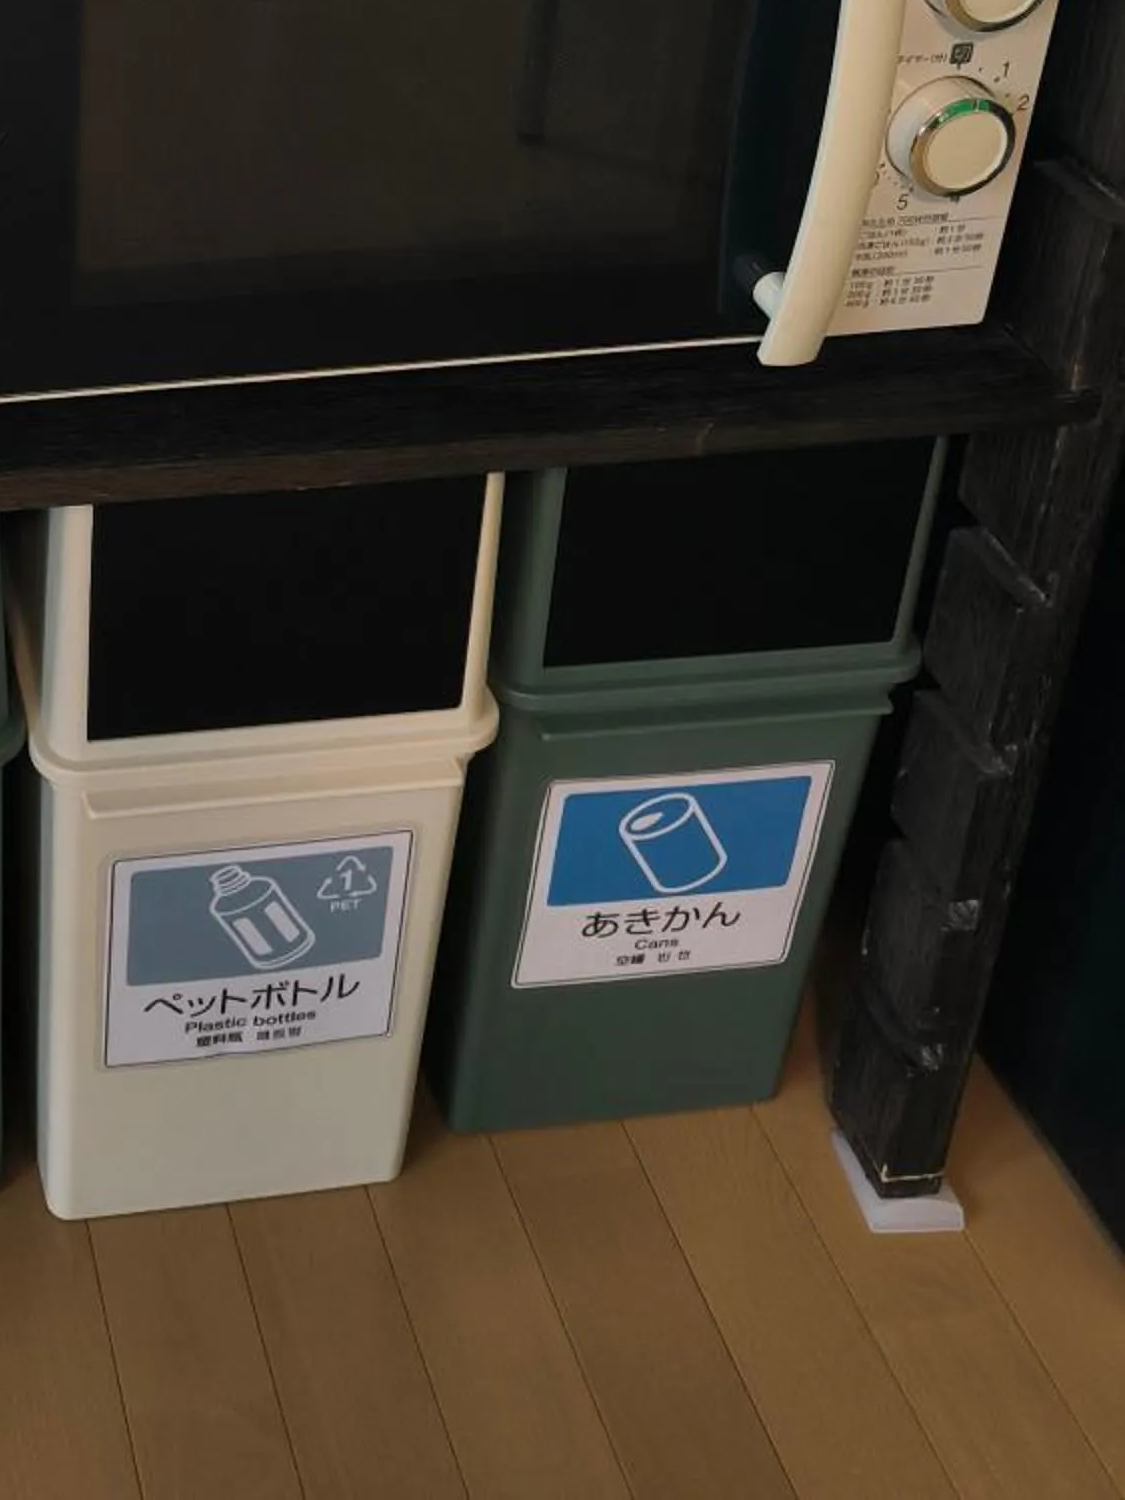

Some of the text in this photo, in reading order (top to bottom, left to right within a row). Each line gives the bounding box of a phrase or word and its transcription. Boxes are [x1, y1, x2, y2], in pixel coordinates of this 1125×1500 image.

[1002, 61, 1010, 77] 1
[1016, 94, 1030, 111] 2
[896, 194, 909, 210] 5
[339, 869, 353, 891] 1
[330, 898, 363, 913] PET
[580, 901, 742, 939] あきかん
[634, 938, 680, 951] Cans
[143, 973, 361, 1018] ペットボトル
[184, 1010, 317, 1034] Plastic bottles
